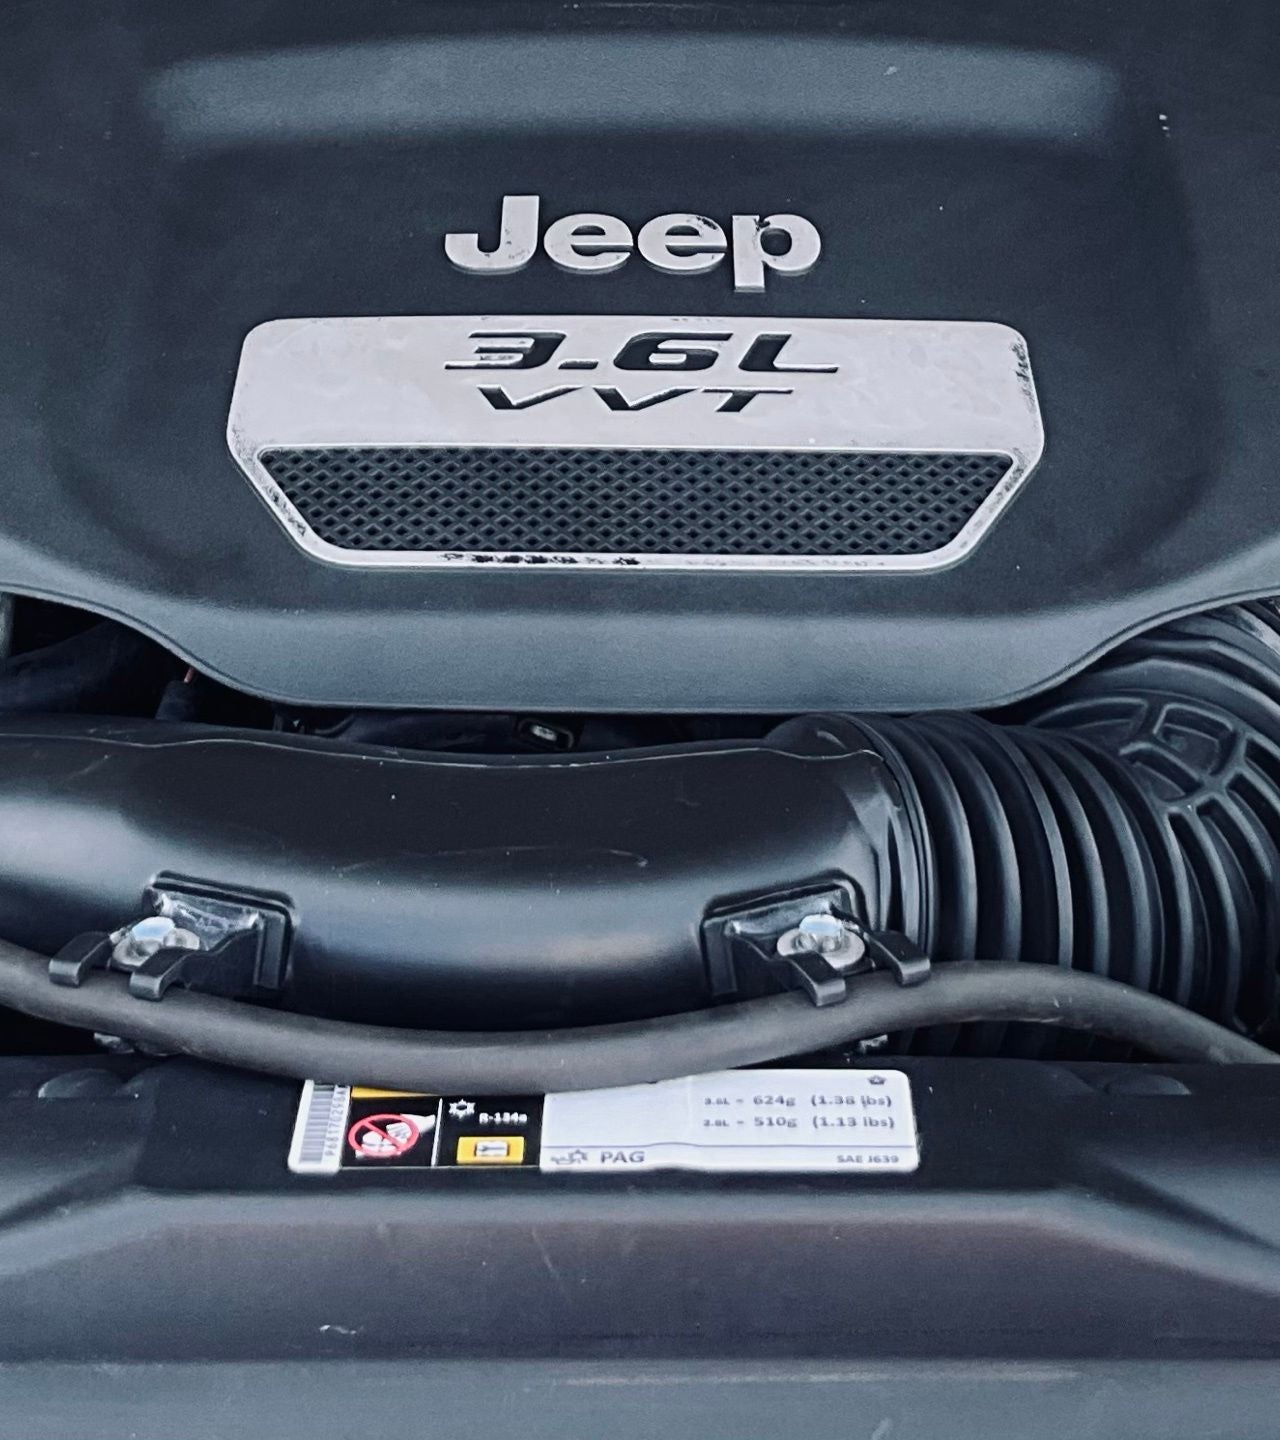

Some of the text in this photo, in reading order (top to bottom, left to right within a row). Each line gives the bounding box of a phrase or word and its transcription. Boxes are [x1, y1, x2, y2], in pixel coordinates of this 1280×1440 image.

[445, 194, 822, 292] Jeep
[444, 331, 840, 373] 3.6L
[476, 384, 795, 413] VVT
[753, 1094, 797, 1108] 624g
[860, 1094, 892, 1108] lbs)
[754, 1116, 798, 1129] 510g
[812, 1115, 857, 1129] (1.13
[863, 1115, 895, 1129] lbs)
[600, 1151, 645, 1164] PAG
[837, 1154, 864, 1164] SAE
